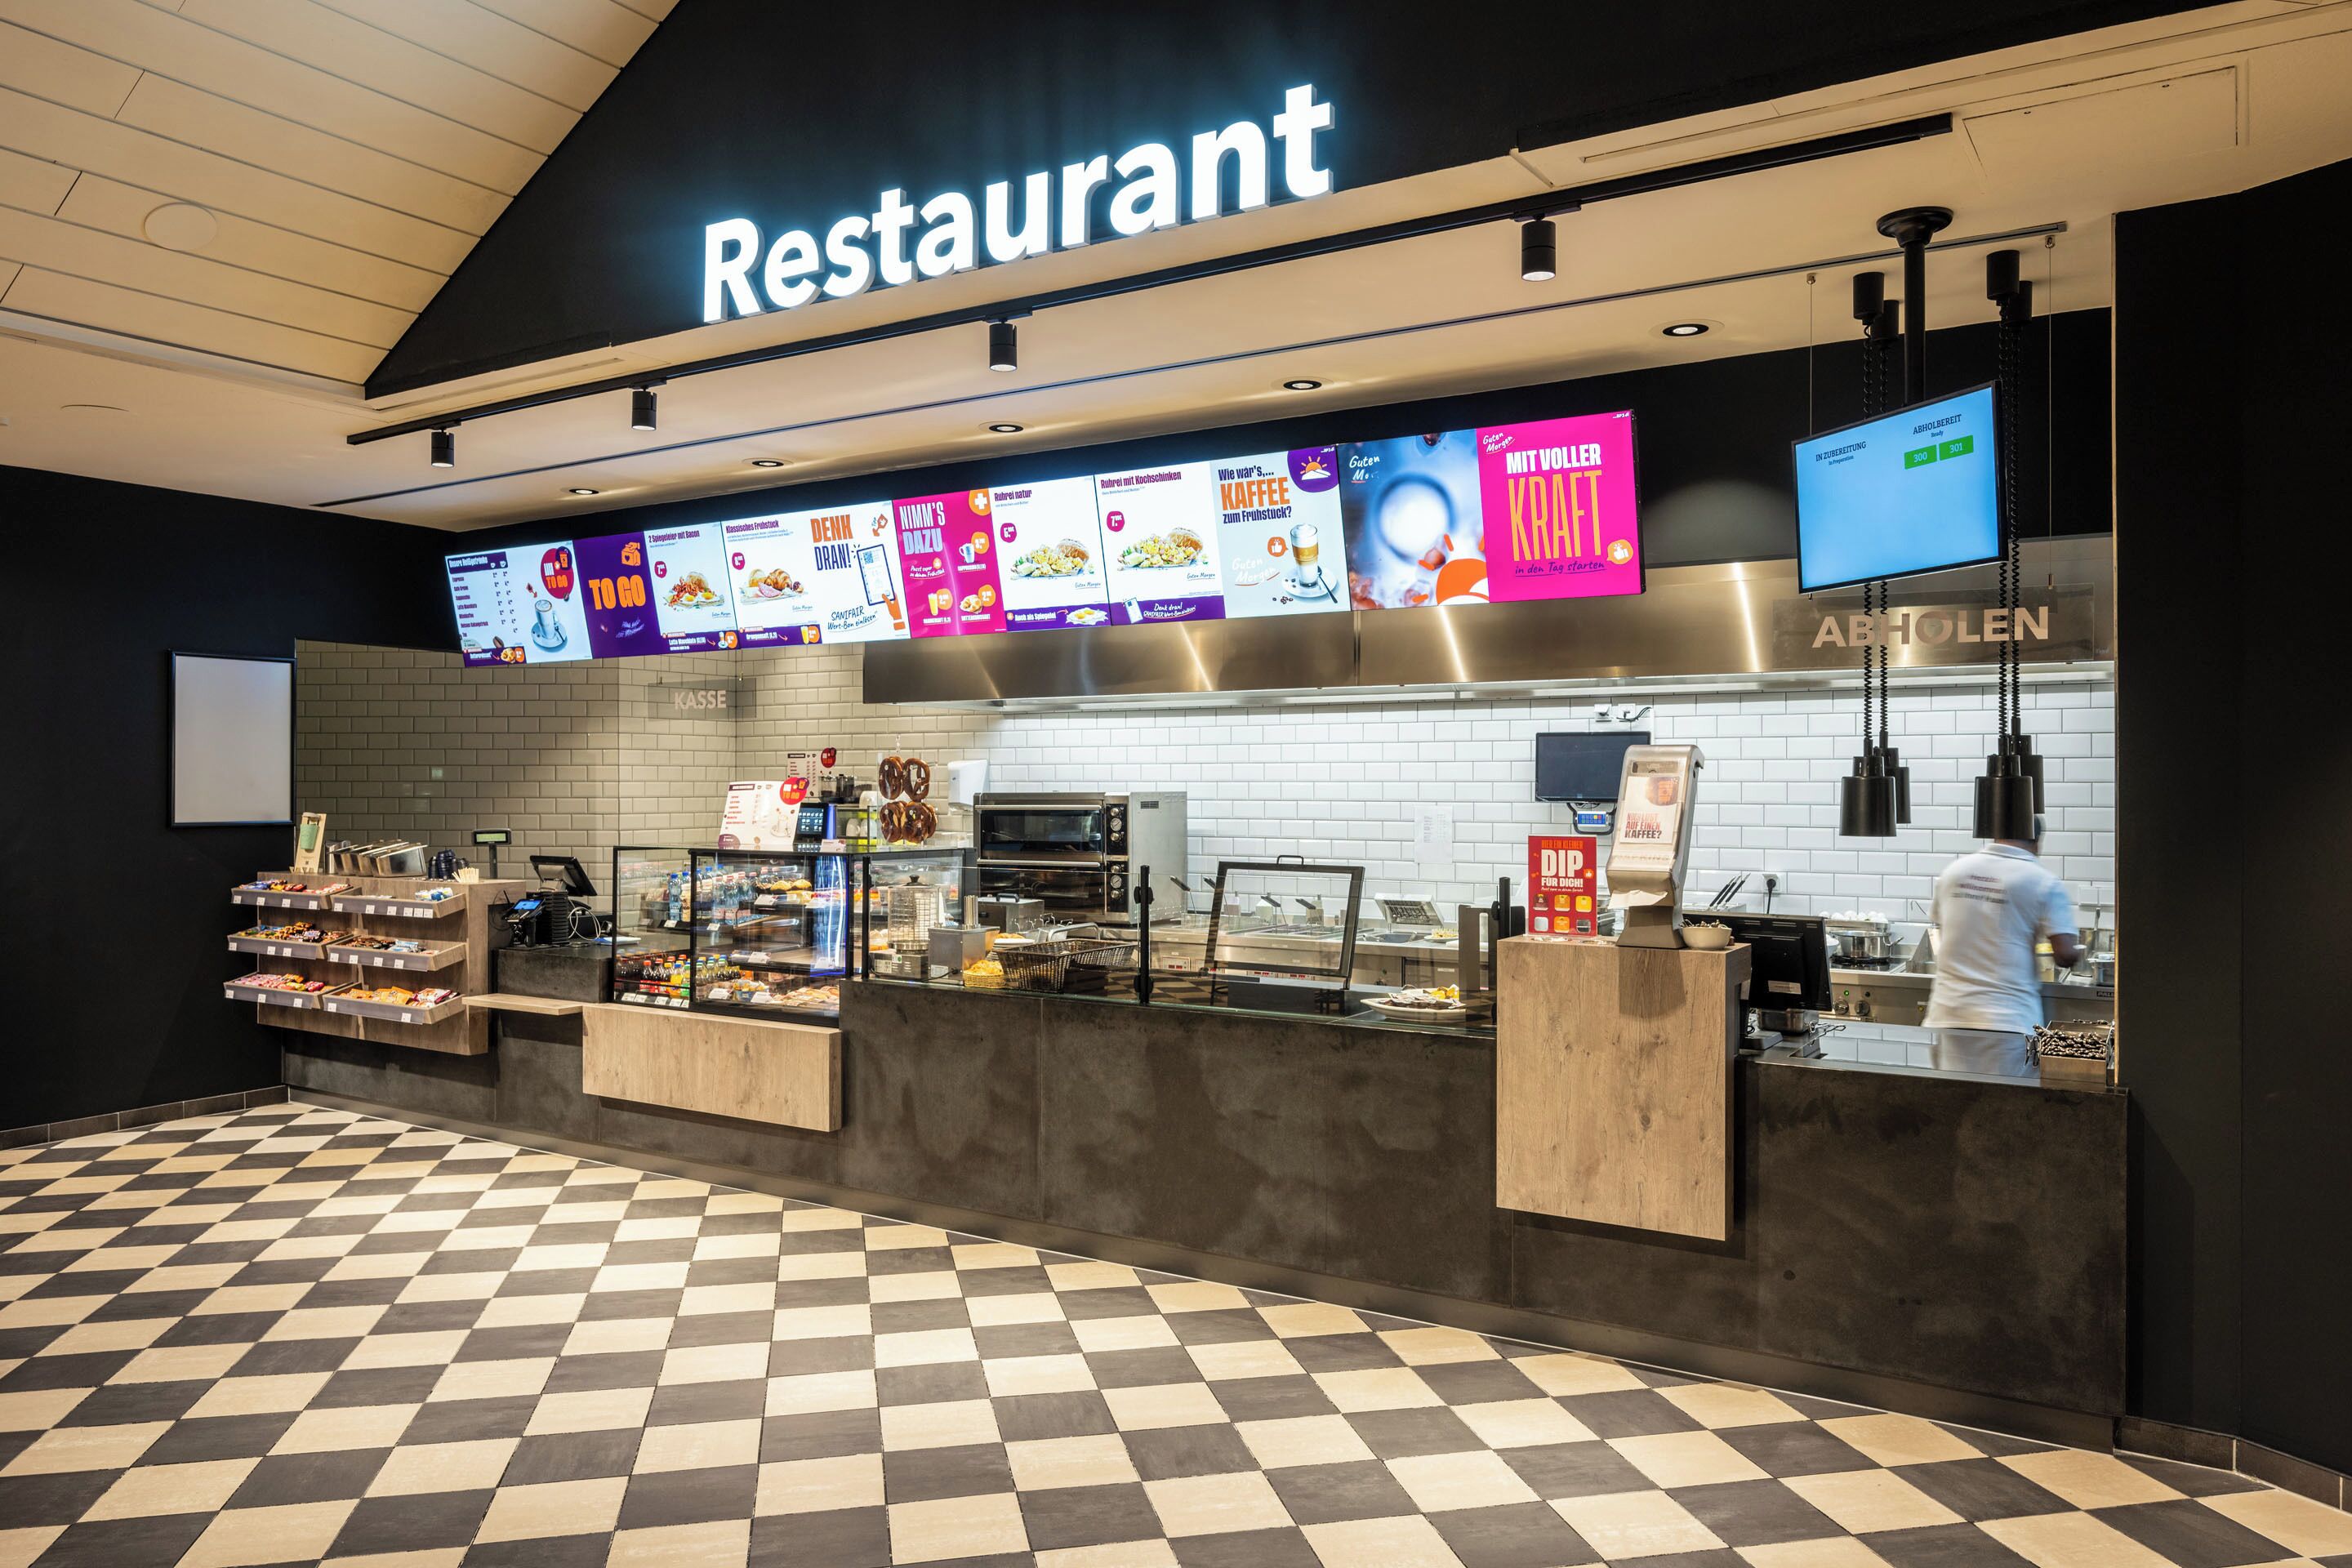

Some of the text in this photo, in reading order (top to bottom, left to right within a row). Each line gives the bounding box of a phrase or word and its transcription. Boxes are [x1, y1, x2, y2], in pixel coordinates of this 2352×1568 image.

[702, 82, 1334, 322] Restaurant
[1913, 414, 1962, 434] ABHOLBEREIT
[1482, 432, 1503, 445] Guten
[1931, 430, 1944, 438] Ready
[1486, 435, 1513, 453] Morgen
[1815, 441, 1867, 462] IN ZUBEREITUNG
[1506, 443, 1601, 474] MIT VOLLER
[1913, 443, 1962, 463] 300 301
[1349, 455, 1380, 468] Guten
[1123, 475, 1134, 486] mit
[1135, 471, 1182, 485] Kochschinken
[1218, 468, 1235, 481] Wie
[1220, 476, 1290, 510] KAFFEE
[899, 501, 946, 529] NIMM'S
[1223, 511, 1241, 524] zum
[1508, 470, 1602, 562] KRAFT
[810, 514, 853, 543] DENK
[648, 535, 652, 543] 2
[902, 528, 943, 555] DAZU
[814, 543, 852, 571] DRAN!
[1232, 557, 1263, 570] Guten
[1235, 566, 1277, 582] Morgen
[1515, 560, 1605, 574] in den Tag starten
[546, 575, 568, 588] TO GO
[589, 574, 646, 610] TO GO
[831, 605, 865, 621] SANIFAIR
[1154, 603, 1168, 611] Denk
[827, 621, 854, 630] Wert-Bon
[1811, 606, 2049, 648] ABHOLEN
[675, 690, 727, 710] KASSE
[1625, 822, 1660, 830] AUF EINEN
[1624, 830, 1663, 840] KAFFEE?
[1540, 849, 1584, 877] DIP
[1541, 876, 1584, 888] FÜR DICH!
